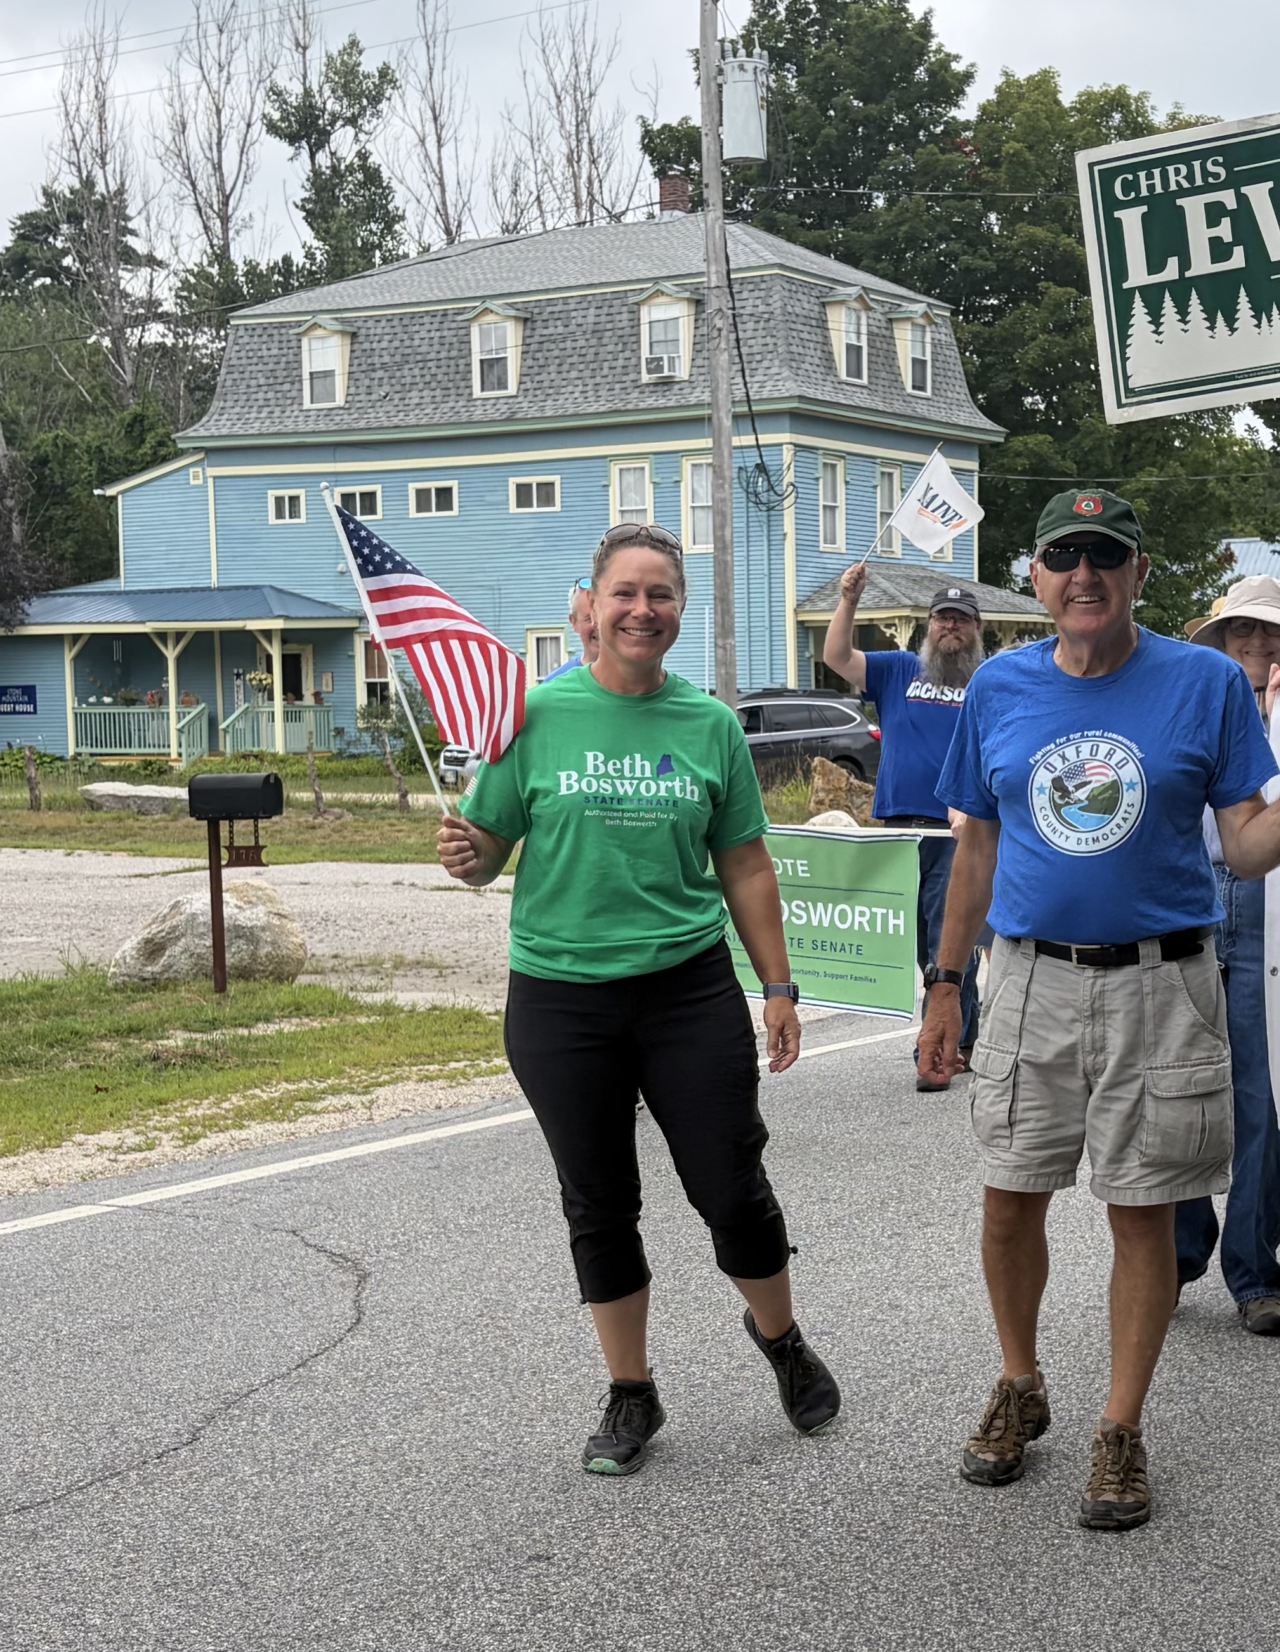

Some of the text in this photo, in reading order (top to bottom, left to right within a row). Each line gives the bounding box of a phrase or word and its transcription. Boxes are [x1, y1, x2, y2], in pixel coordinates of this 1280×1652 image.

[1113, 156, 1228, 200] CHRIS
[905, 681, 966, 702] JACKSO
[0, 703, 14, 712] UEST
[1056, 736, 1067, 745] for
[1084, 729, 1103, 737] rural
[584, 751, 652, 778] Beth
[1043, 743, 1130, 774] OXFORD
[557, 771, 700, 802] Bosworth
[584, 796, 679, 808] STATE SENATE
[584, 809, 622, 817] Authorized
[623, 819, 657, 827] Bosworth
[1039, 806, 1071, 843] COUNTY
[1076, 802, 1135, 846] DEMOCRATS
[772, 857, 811, 877] OTE
[811, 939, 864, 956] SENATE
[823, 970, 848, 981] Support
